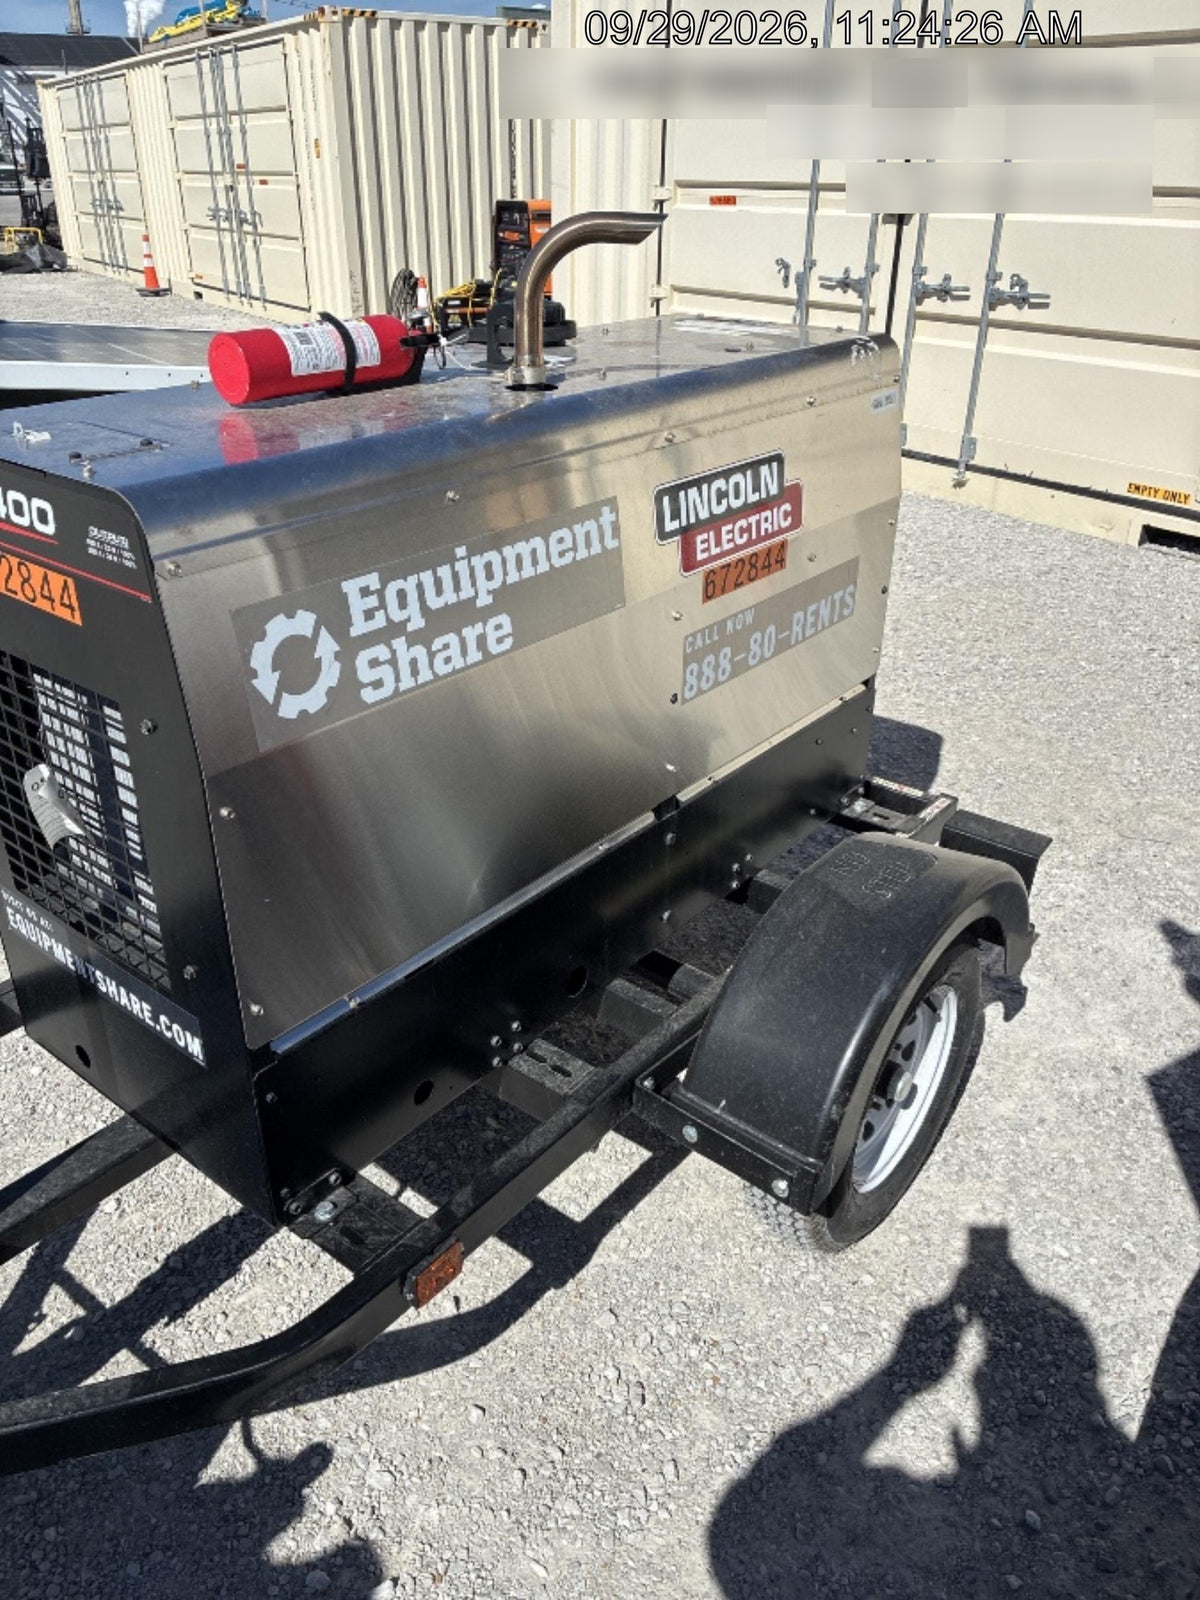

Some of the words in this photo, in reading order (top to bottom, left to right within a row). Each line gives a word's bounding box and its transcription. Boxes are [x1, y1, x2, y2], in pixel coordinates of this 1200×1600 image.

[662, 461, 779, 533] LINCOLN
[1127, 482, 1160, 499] EMPTY
[1162, 489, 1191, 505] ONLY
[695, 502, 793, 562] ELECTRIC
[340, 505, 620, 638] Equipment
[704, 543, 786, 601] 672844
[355, 612, 515, 705] Share
[683, 584, 855, 700] 888-80-RENTS
[685, 625, 720, 654] CALL
[726, 607, 756, 635] NOW
[6, 906, 204, 1060] EQUIPMENTSHARE.COM
